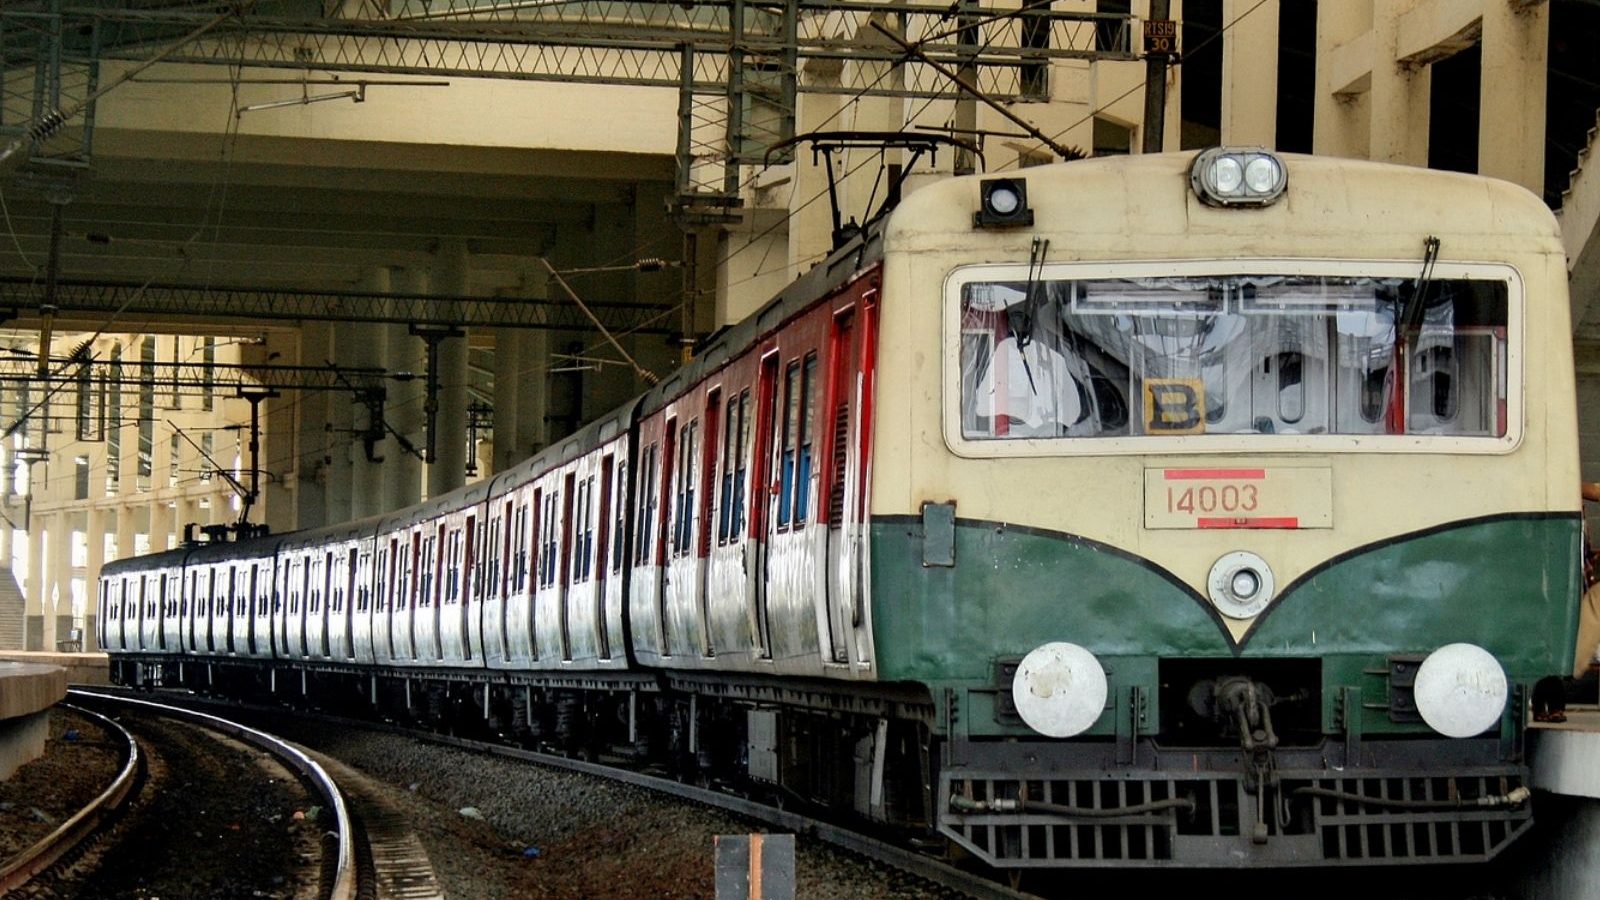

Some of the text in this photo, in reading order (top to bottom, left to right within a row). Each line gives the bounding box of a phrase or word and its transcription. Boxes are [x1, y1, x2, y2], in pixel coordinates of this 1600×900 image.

[1151, 38, 1169, 51] 30
[1149, 384, 1201, 430] B
[1166, 484, 1259, 515] 14003
